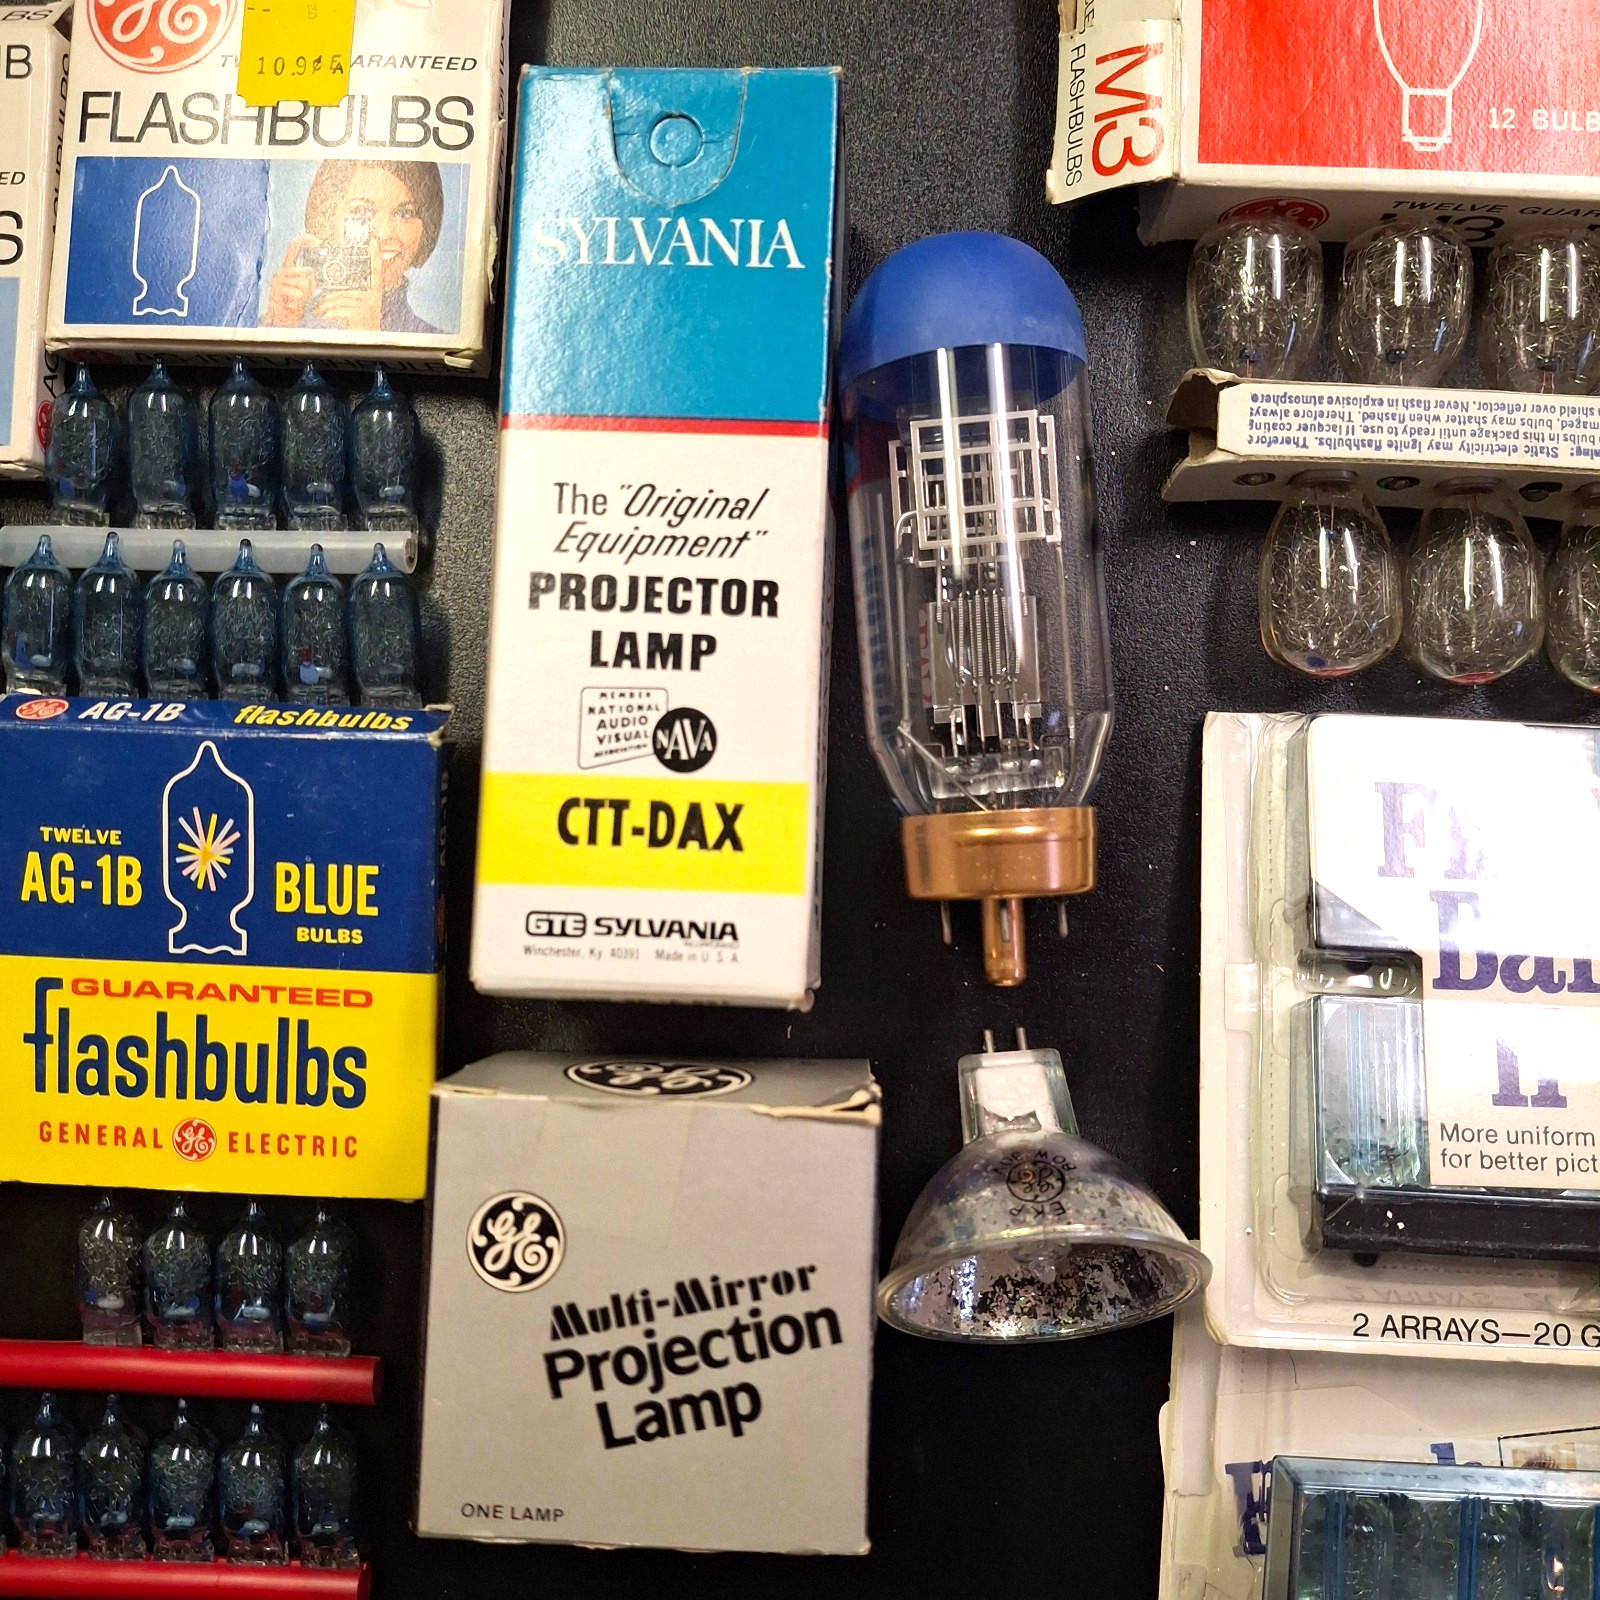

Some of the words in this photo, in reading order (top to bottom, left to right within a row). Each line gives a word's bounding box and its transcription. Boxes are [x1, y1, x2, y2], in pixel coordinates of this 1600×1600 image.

[349, 54, 478, 72] ARANTEED
[1065, 43, 1087, 187] FLASHBULBS
[1092, 42, 1165, 177] M3
[77, 90, 476, 152] FLASHBULBS
[1488, 107, 1516, 130] 12
[1393, 200, 1509, 214] TWELVE
[531, 216, 806, 269] SYLVANIA
[1327, 395, 1384, 409] explosive
[1387, 398, 1399, 410] in
[1402, 398, 1430, 411] flash
[1434, 400, 1469, 413] Never
[1473, 401, 1526, 414] reflector.
[1293, 409, 1354, 422] Therefore
[1530, 405, 1556, 414] over
[1560, 406, 1594, 418] shield
[1358, 411, 1405, 424] flashed.
[1409, 414, 1441, 425] when
[1445, 415, 1487, 427] shatter
[1492, 415, 1516, 426] may
[1520, 418, 1552, 430] bulbs
[1249, 419, 1292, 433] coating
[1296, 422, 1342, 436] lacquer
[1345, 425, 1355, 436] If
[1360, 425, 1383, 434] use.
[1387, 426, 1398, 437] to
[1402, 424, 1435, 438] ready
[1440, 428, 1466, 439] until
[1470, 428, 1519, 441] package
[1523, 432, 1545, 443] this
[1549, 433, 1559, 444] in
[1563, 434, 1595, 445] bulbs
[1248, 435, 1309, 449] Therefore
[1315, 437, 1382, 451] flashbulbs.
[1427, 439, 1453, 451] may
[1459, 441, 1518, 456] electricity
[1524, 445, 1559, 458] Static
[553, 482, 608, 516] The
[619, 483, 770, 528] "Original
[553, 520, 770, 565] Equipment"
[528, 571, 780, 619] PROJECTOR
[589, 629, 718, 672] LAMP
[78, 701, 187, 723] AG-1B
[233, 704, 414, 731] flashbulbs
[587, 703, 661, 716] NATIONAL
[596, 715, 649, 731] AUDIO
[596, 729, 650, 746] VISUAL
[655, 717, 714, 761] NAVA
[557, 797, 745, 852] CTT-DAX
[39, 825, 122, 846] TWELVE
[20, 850, 143, 907] AG-1B
[275, 861, 380, 917] BLUE
[526, 911, 587, 938] GTE
[594, 916, 739, 942] SYLVANIA
[296, 926, 364, 945] BULBS
[655, 949, 684, 962] Made
[688, 950, 698, 962] in
[71, 977, 373, 1008] GUARANTEED
[23, 976, 367, 1109] flashbulbs
[39, 1120, 164, 1149] GENERAL
[229, 1131, 358, 1159] ELECTRIC
[1439, 1122, 1498, 1144] More
[1506, 1125, 1596, 1147] uniform
[1440, 1148, 1472, 1168] for
[1480, 1150, 1548, 1171] better
[549, 1264, 818, 1341] Multi-Mirror
[1352, 1312, 1370, 1337] 2
[542, 1305, 844, 1400] Projection
[595, 1379, 763, 1450] Lamp
[460, 1502, 504, 1521] ONE
[510, 1506, 565, 1525] LAMP
